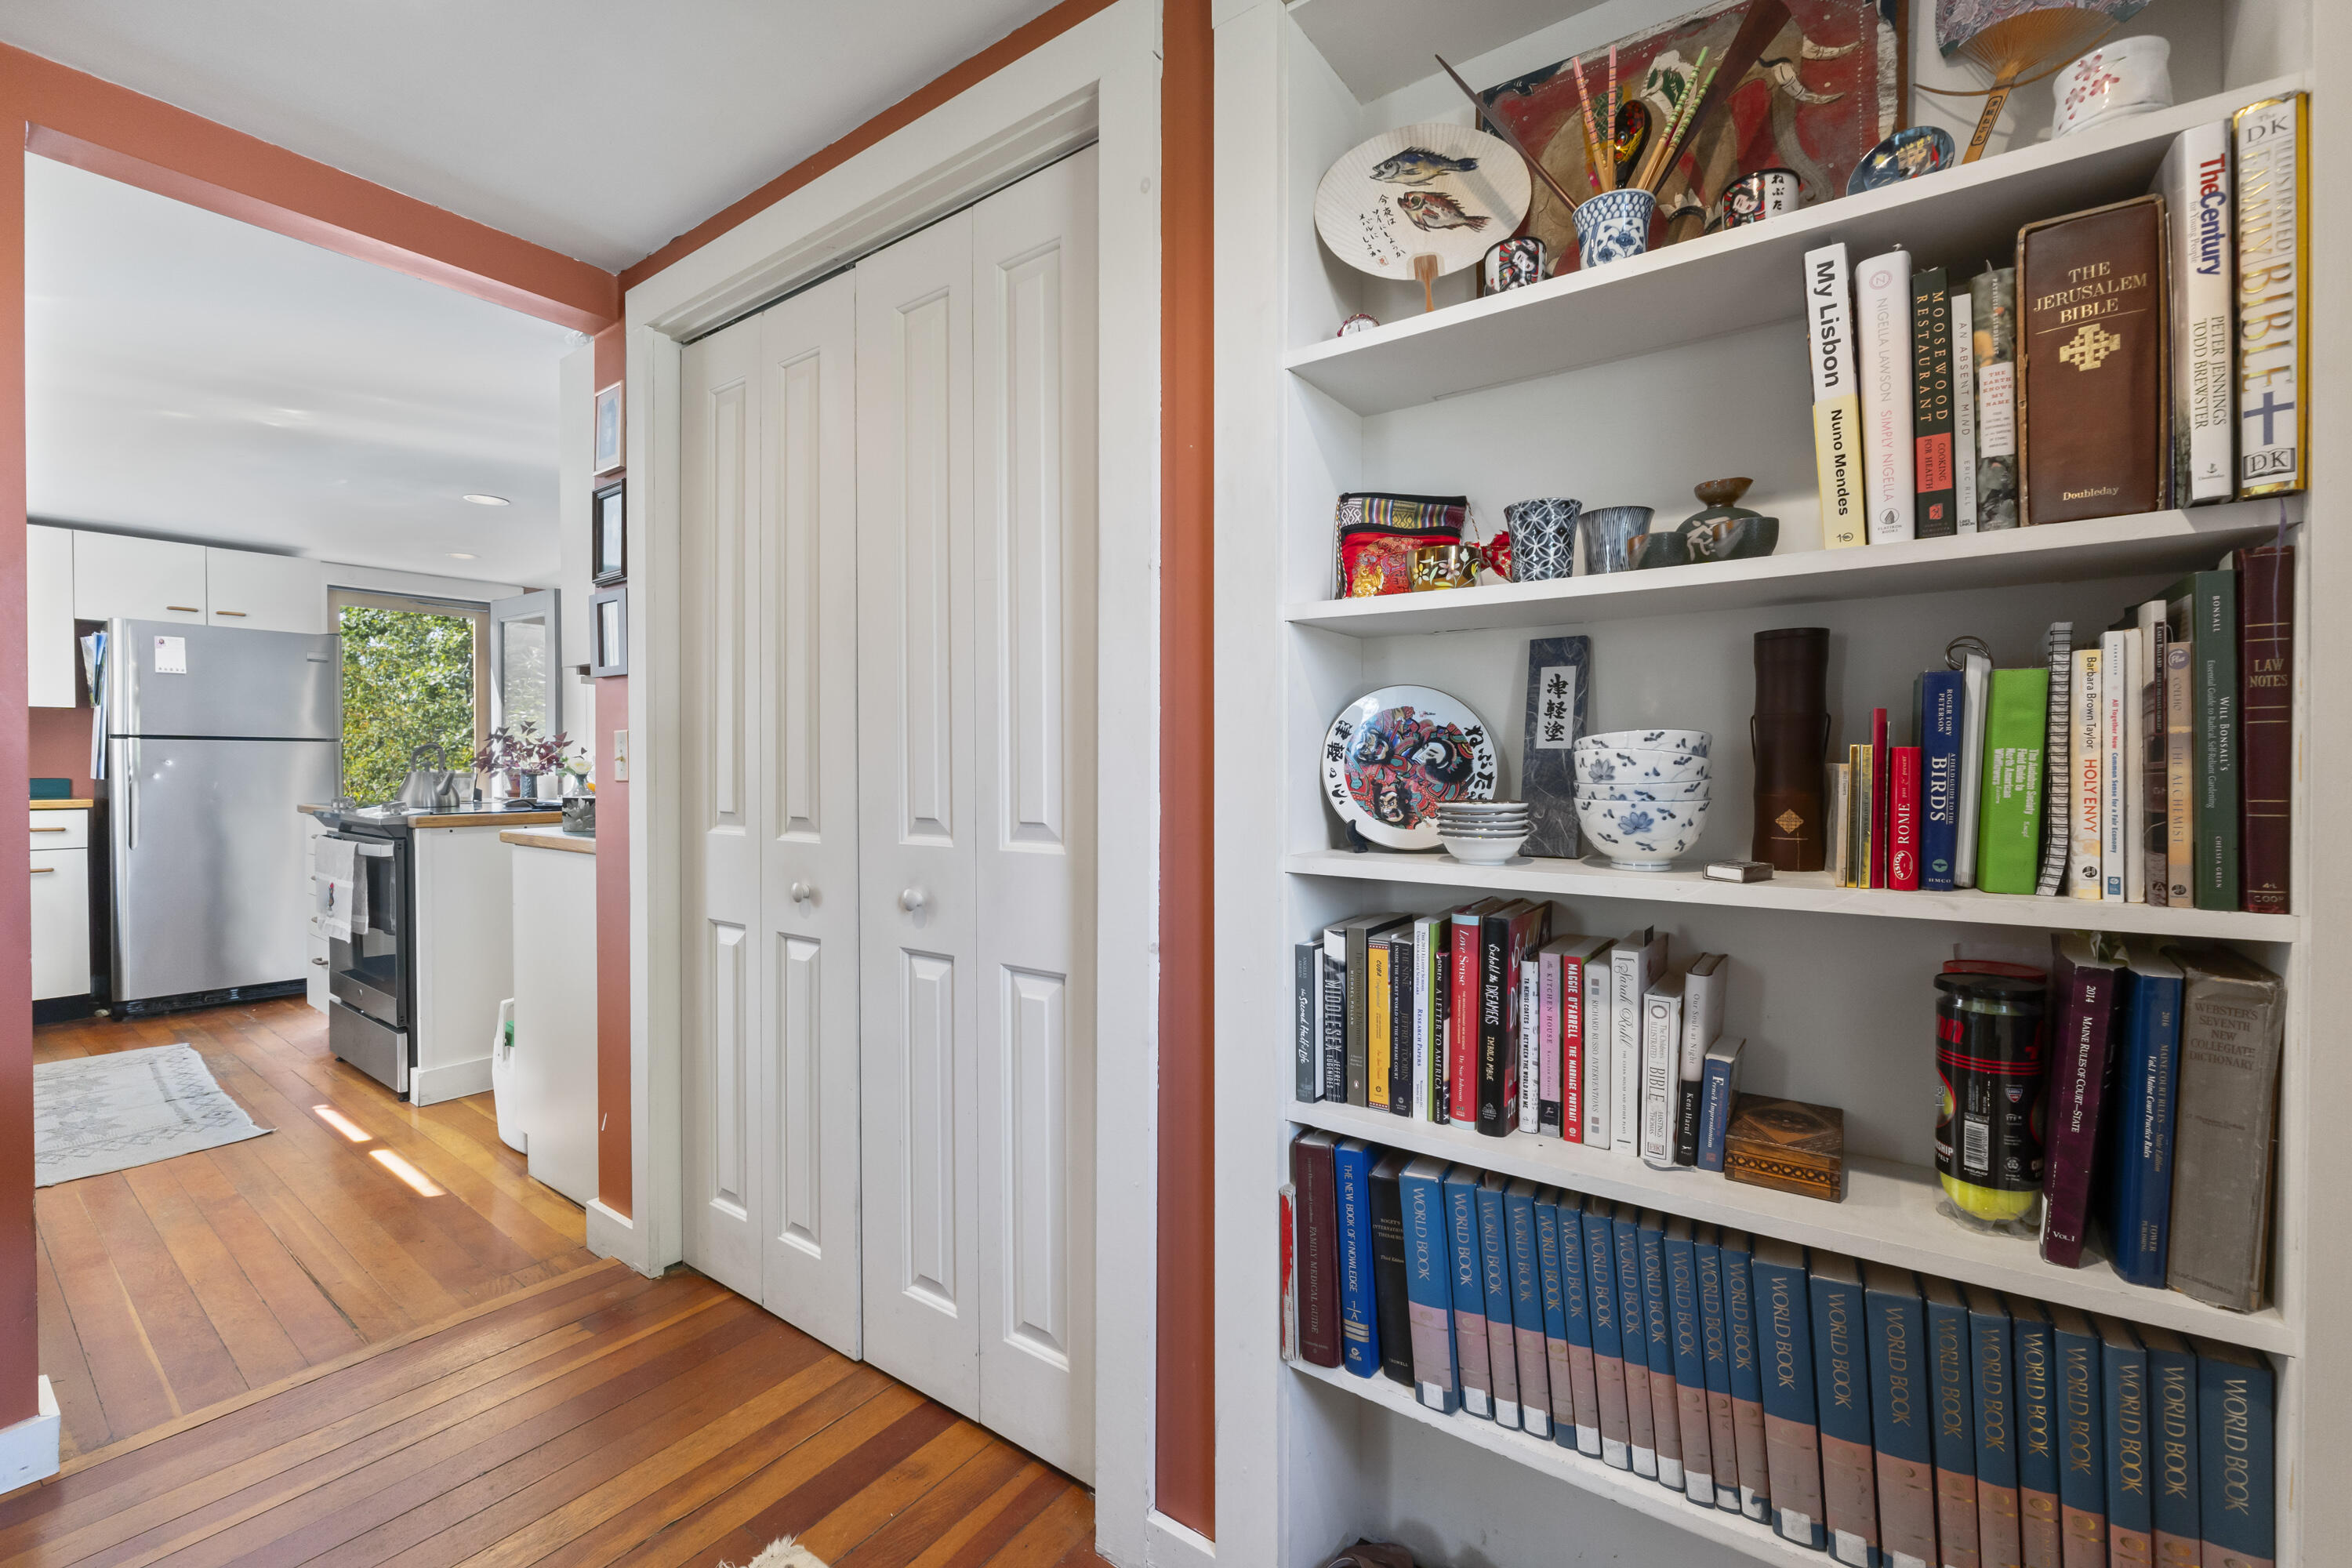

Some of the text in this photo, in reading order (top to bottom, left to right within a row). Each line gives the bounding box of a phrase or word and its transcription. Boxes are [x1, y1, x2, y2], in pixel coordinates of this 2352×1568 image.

[2241, 149, 2272, 254] FAMILY
[2033, 273, 2148, 312] JERUSALEM
[2068, 261, 2111, 284] THE
[1813, 260, 1842, 387] My Lisbon
[2060, 298, 2118, 324] BIBLE
[2241, 263, 2295, 393] BIBLE
[1917, 295, 1933, 422] RESTAURANT
[1933, 291, 1948, 420] MOOSEWOOD
[1958, 322, 1970, 436] AN ABSENT MIND
[1984, 377, 2012, 386] EARTH
[2194, 318, 2209, 430] TODD BREWSTER
[2209, 315, 2227, 426] PETER JENNINGS
[1877, 297, 1895, 503] NIGELLA LAWSON SIMPLY NIGELLA
[1831, 409, 1850, 516] Nuno Mendes
[1925, 457, 1934, 490] HEALTH
[1937, 443, 1947, 482] COOKING
[2063, 485, 2120, 501] Doubleday
[2251, 451, 2288, 473] DK
[2212, 594, 2221, 633] BONSALL
[2249, 675, 2288, 688] NOTES
[2254, 659, 2285, 673] LAW
[1544, 673, 1569, 742] 津軽塗
[2083, 657, 2096, 749] Barbara Brown Taylor
[2205, 659, 2217, 808] Essential Guide Gardening
[2220, 696, 2230, 772] WILL BONSALL'S
[1929, 756, 1947, 822] BIRDS
[1992, 748, 2004, 786] Wildflowers
[2003, 748, 2016, 798] North American
[2016, 748, 2027, 783] Field Guide
[2024, 749, 2039, 815] The Audubon Society
[2084, 759, 2098, 833] HOLY ENVY
[1897, 803, 1911, 844] ROME
[2172, 775, 2183, 843] ALCHEMIST
[1893, 851, 1905, 879] VISION
[1458, 929, 1470, 986] Love Sense
[1568, 963, 1578, 993] MAGGIE
[1325, 979, 1342, 1052] MIDDLESEX
[1485, 984, 1499, 1026] DREAMERS
[1568, 996, 1578, 1039] O'FARRELL
[1614, 963, 1634, 1049] Sarah Ruhl
[2078, 985, 2096, 1068] 2014 MAINE RULES
[2196, 1002, 2258, 1020] WEBSTER'S
[2199, 1015, 2251, 1033] SEVENTH
[2211, 1029, 2237, 1041] NEW
[1486, 1036, 1495, 1082] IMBOLO MBUE
[1569, 1045, 1577, 1058] THE
[1689, 1043, 1697, 1065] Night
[2158, 1011, 2170, 1098] 2016 MAINE COURT
[2189, 1051, 2254, 1071] DICTIONARY
[2190, 1038, 2256, 1058] COLLEGIATE
[1649, 1066, 1666, 1103] BIBLE
[1684, 1092, 1694, 1136] Kent Haruf
[1708, 1076, 1725, 1148] French Impressionism
[2143, 1074, 2156, 1159] Maine Court Practice Rules
[1309, 1225, 1318, 1259] FAMILY
[1344, 1164, 1358, 1293] THE NEW BOOK KNOWLEDGE
[1413, 1187, 1430, 1281] WORLD BOOK
[1483, 1202, 1502, 1297] WORLD BOOK
[2150, 1225, 2158, 1252] TOWER
[1539, 1215, 1560, 1312] WORLD BOOK
[1591, 1228, 1612, 1330] WORLD BOOK
[1700, 1256, 1724, 1363] WORLD BOOK
[1770, 1277, 1795, 1391] WORLD BOOK
[1886, 1308, 1911, 1428] WORLD BOOK
[1981, 1329, 2005, 1453] WORLD BOOK
[2163, 1367, 2187, 1499] WORLD BOOK
[2223, 1380, 2249, 1515] WORLD BOOK
